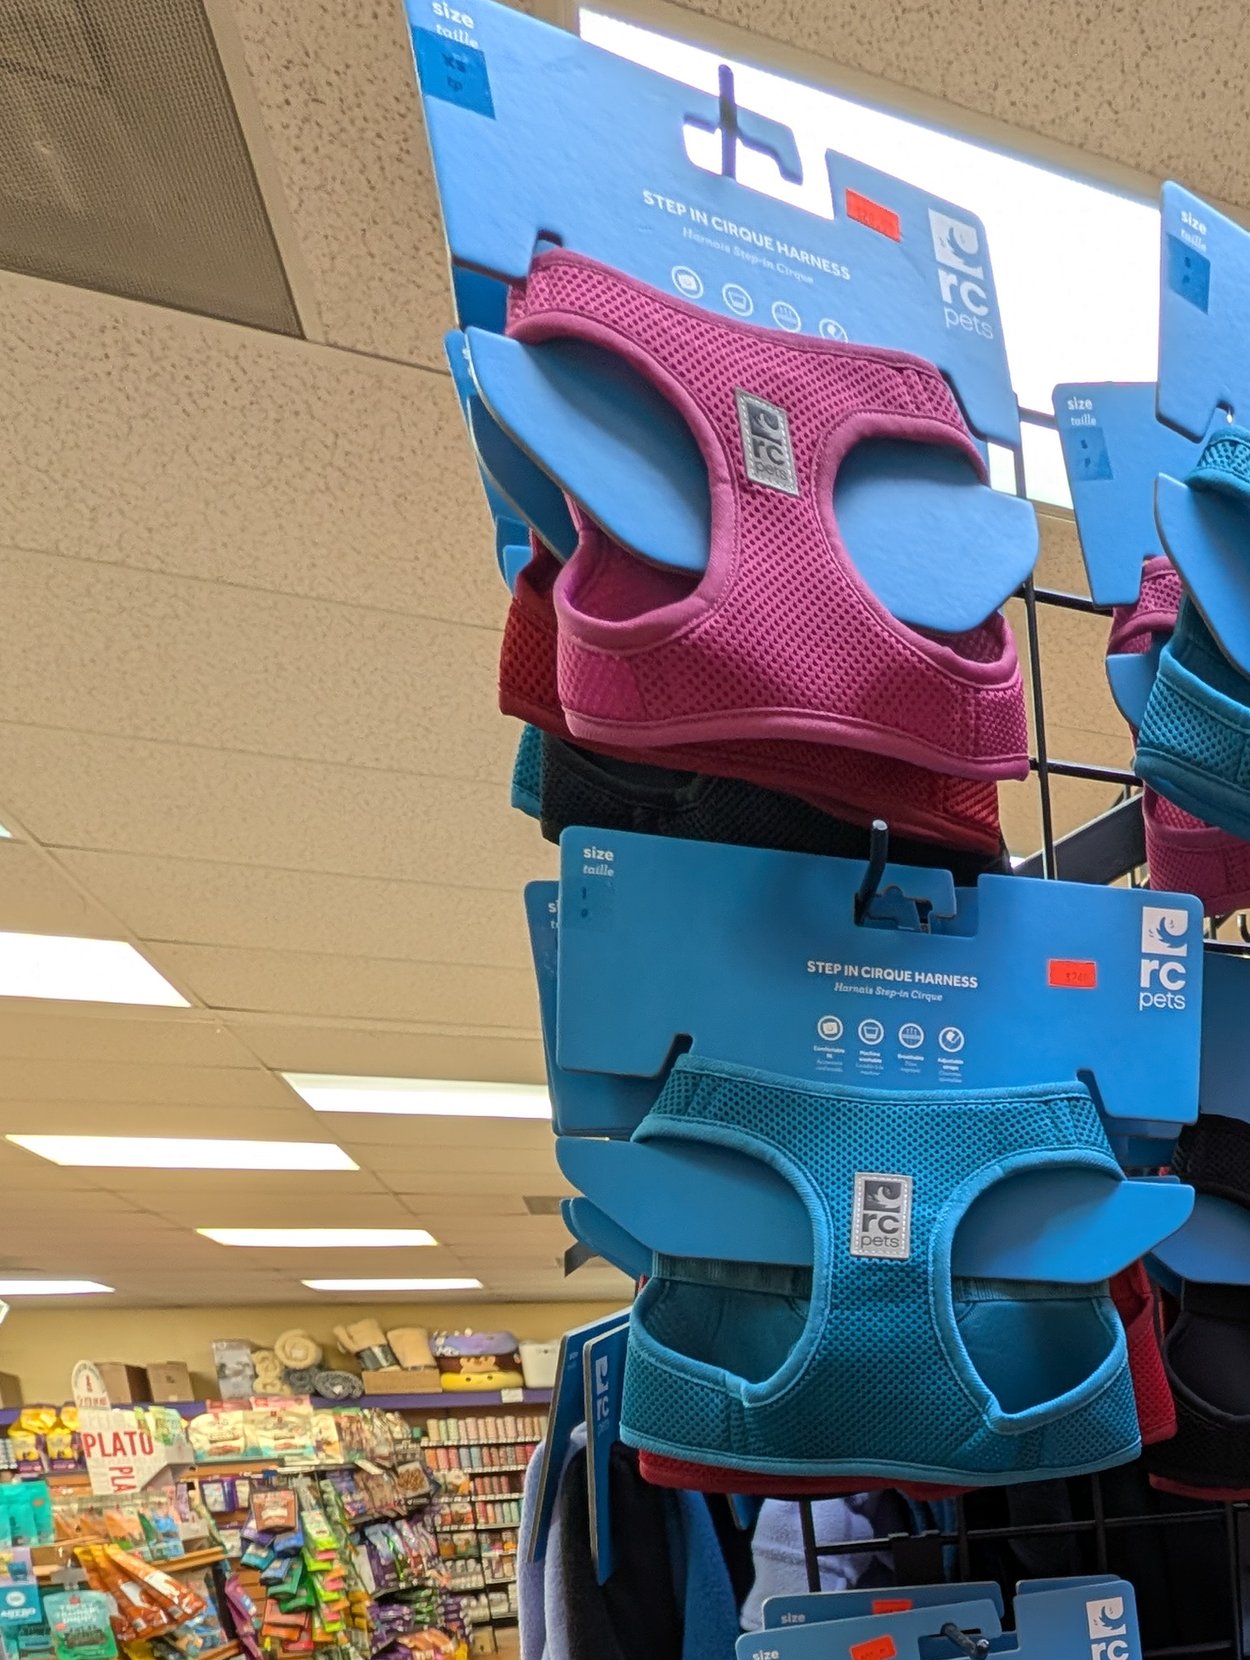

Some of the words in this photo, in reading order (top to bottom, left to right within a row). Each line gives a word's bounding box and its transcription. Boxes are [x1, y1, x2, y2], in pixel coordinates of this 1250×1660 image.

[432, 0, 475, 29] size
[1180, 210, 1207, 235] size
[643, 190, 686, 215] STEP
[690, 206, 708, 224] IN
[711, 213, 774, 252] CIRQUE
[776, 242, 850, 281] HARNESS
[937, 267, 989, 316] rc
[944, 308, 994, 340] pets
[1067, 396, 1093, 410] size
[752, 438, 785, 466] rc
[583, 846, 614, 861] size
[583, 864, 614, 876] taille
[807, 961, 841, 974] STEP
[844, 965, 858, 977] IN
[861, 967, 912, 983] CIRQUE
[915, 972, 978, 988] HARNESS
[1140, 959, 1186, 991] rc
[834, 982, 873, 995] Harnais
[875, 987, 909, 998] Step-in
[911, 990, 943, 1002] Cirque
[1139, 992, 1186, 1011] pets
[862, 1213, 900, 1235] rc
[861, 1235, 900, 1248] pets
[781, 1612, 805, 1625] size
